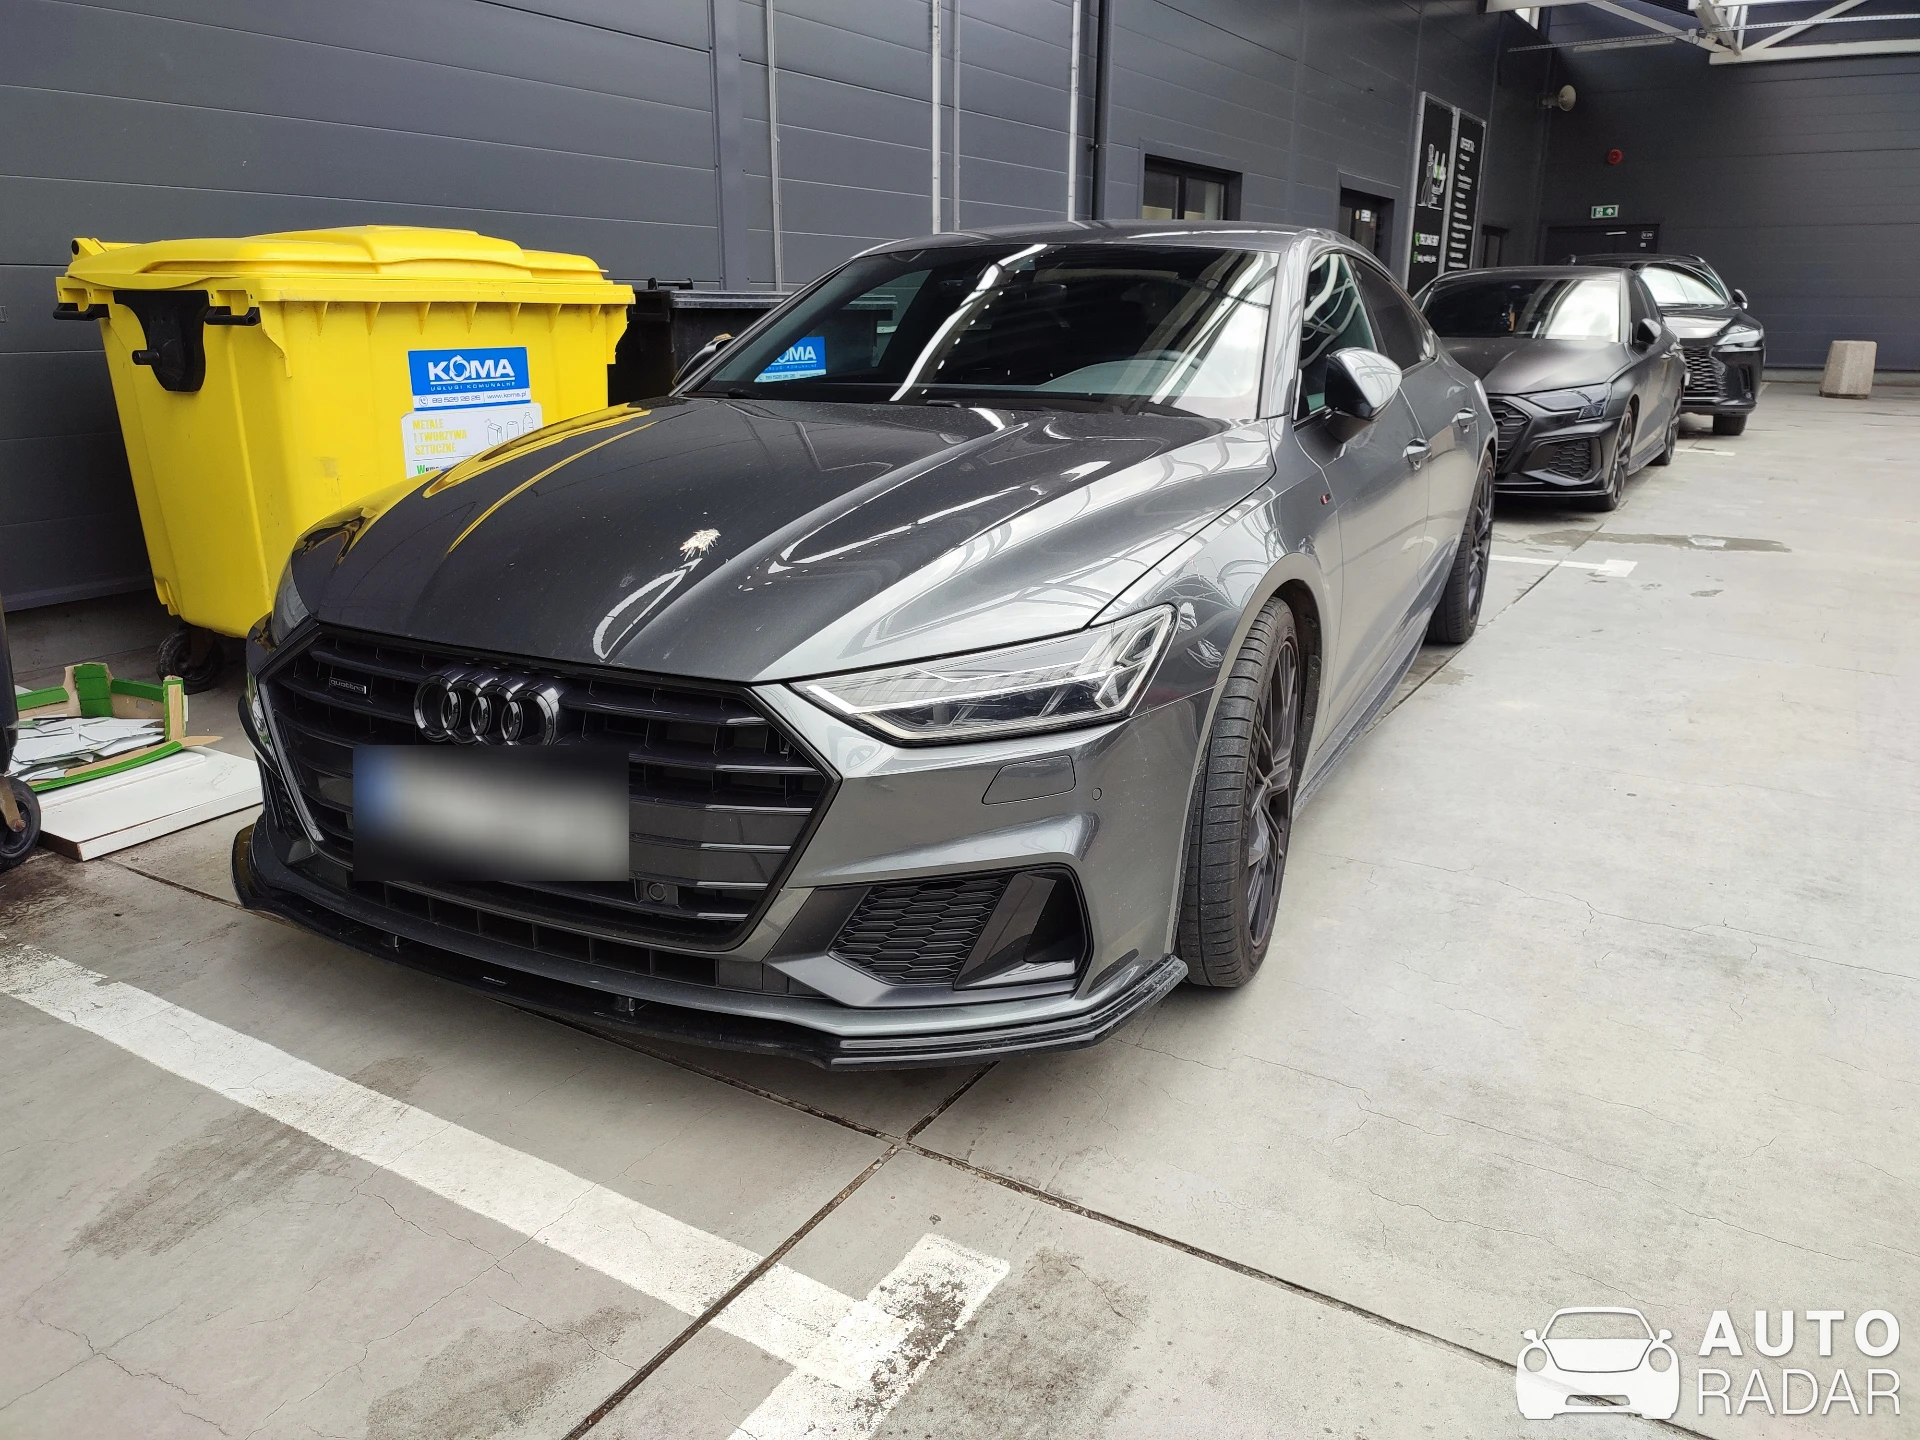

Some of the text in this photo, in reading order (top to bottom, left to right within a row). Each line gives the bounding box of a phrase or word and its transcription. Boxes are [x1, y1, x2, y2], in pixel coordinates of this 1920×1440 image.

[775, 346, 816, 363] OMA
[428, 355, 515, 381] KOMA
[413, 419, 443, 430] METALE
[419, 429, 467, 442] TWORZYWA
[415, 443, 456, 455] SZTUCZNE
[330, 679, 363, 691] quattro
[1242, 707, 1262, 840] MICHELIN
